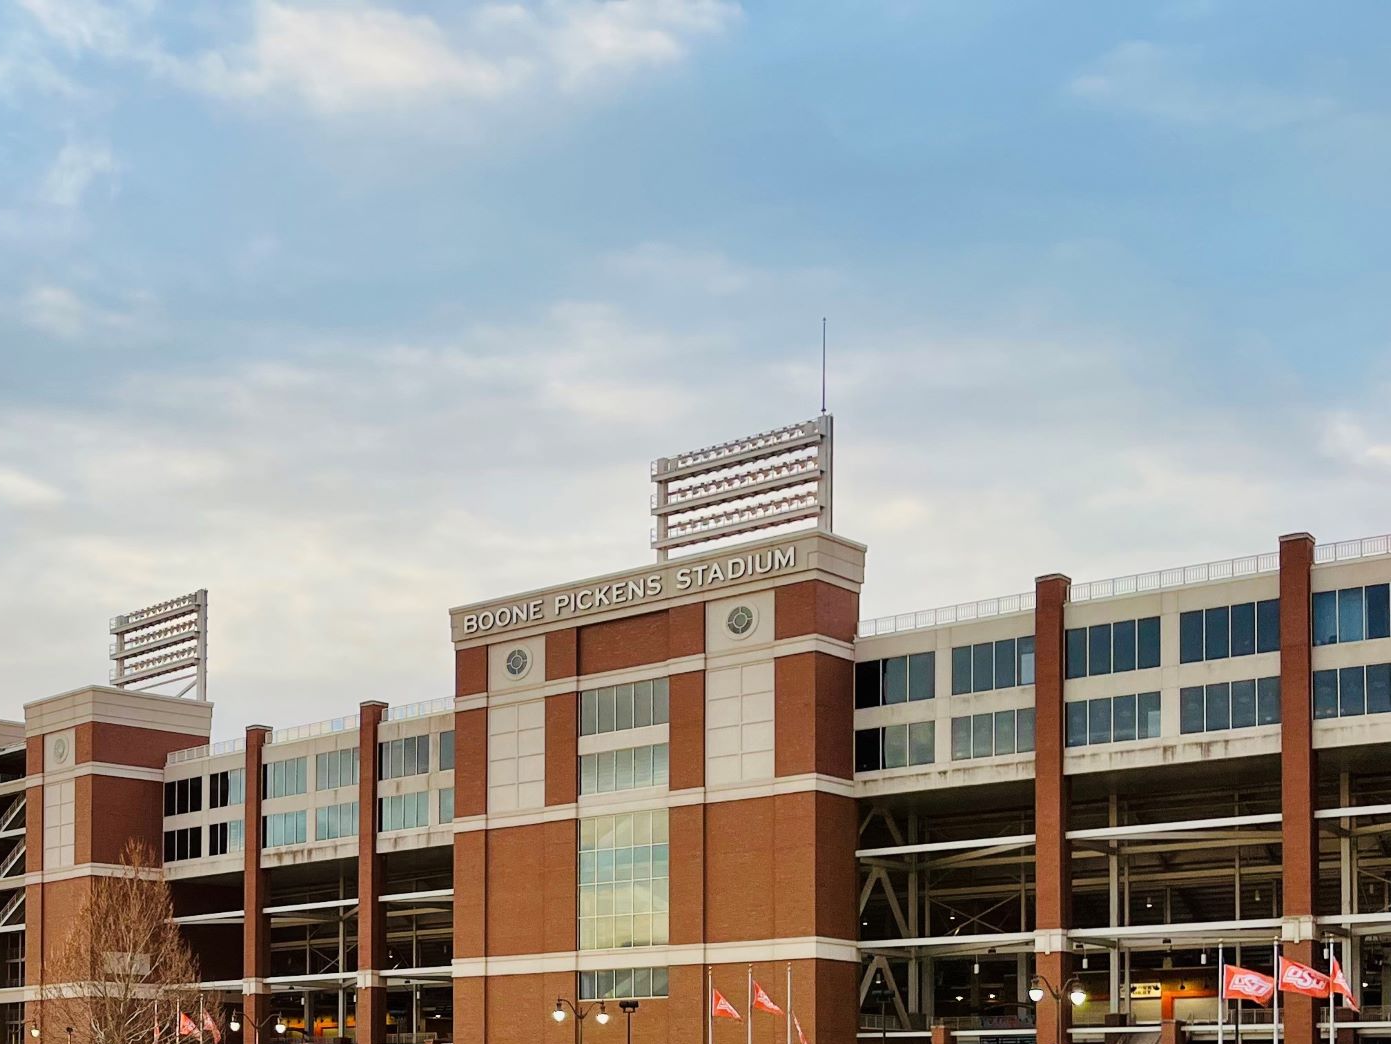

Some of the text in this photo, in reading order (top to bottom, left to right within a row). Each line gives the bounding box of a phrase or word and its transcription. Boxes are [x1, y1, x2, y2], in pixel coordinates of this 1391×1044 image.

[463, 546, 797, 634] BOONE PICKENS STADIUM
[1282, 965, 1328, 990] OSU
